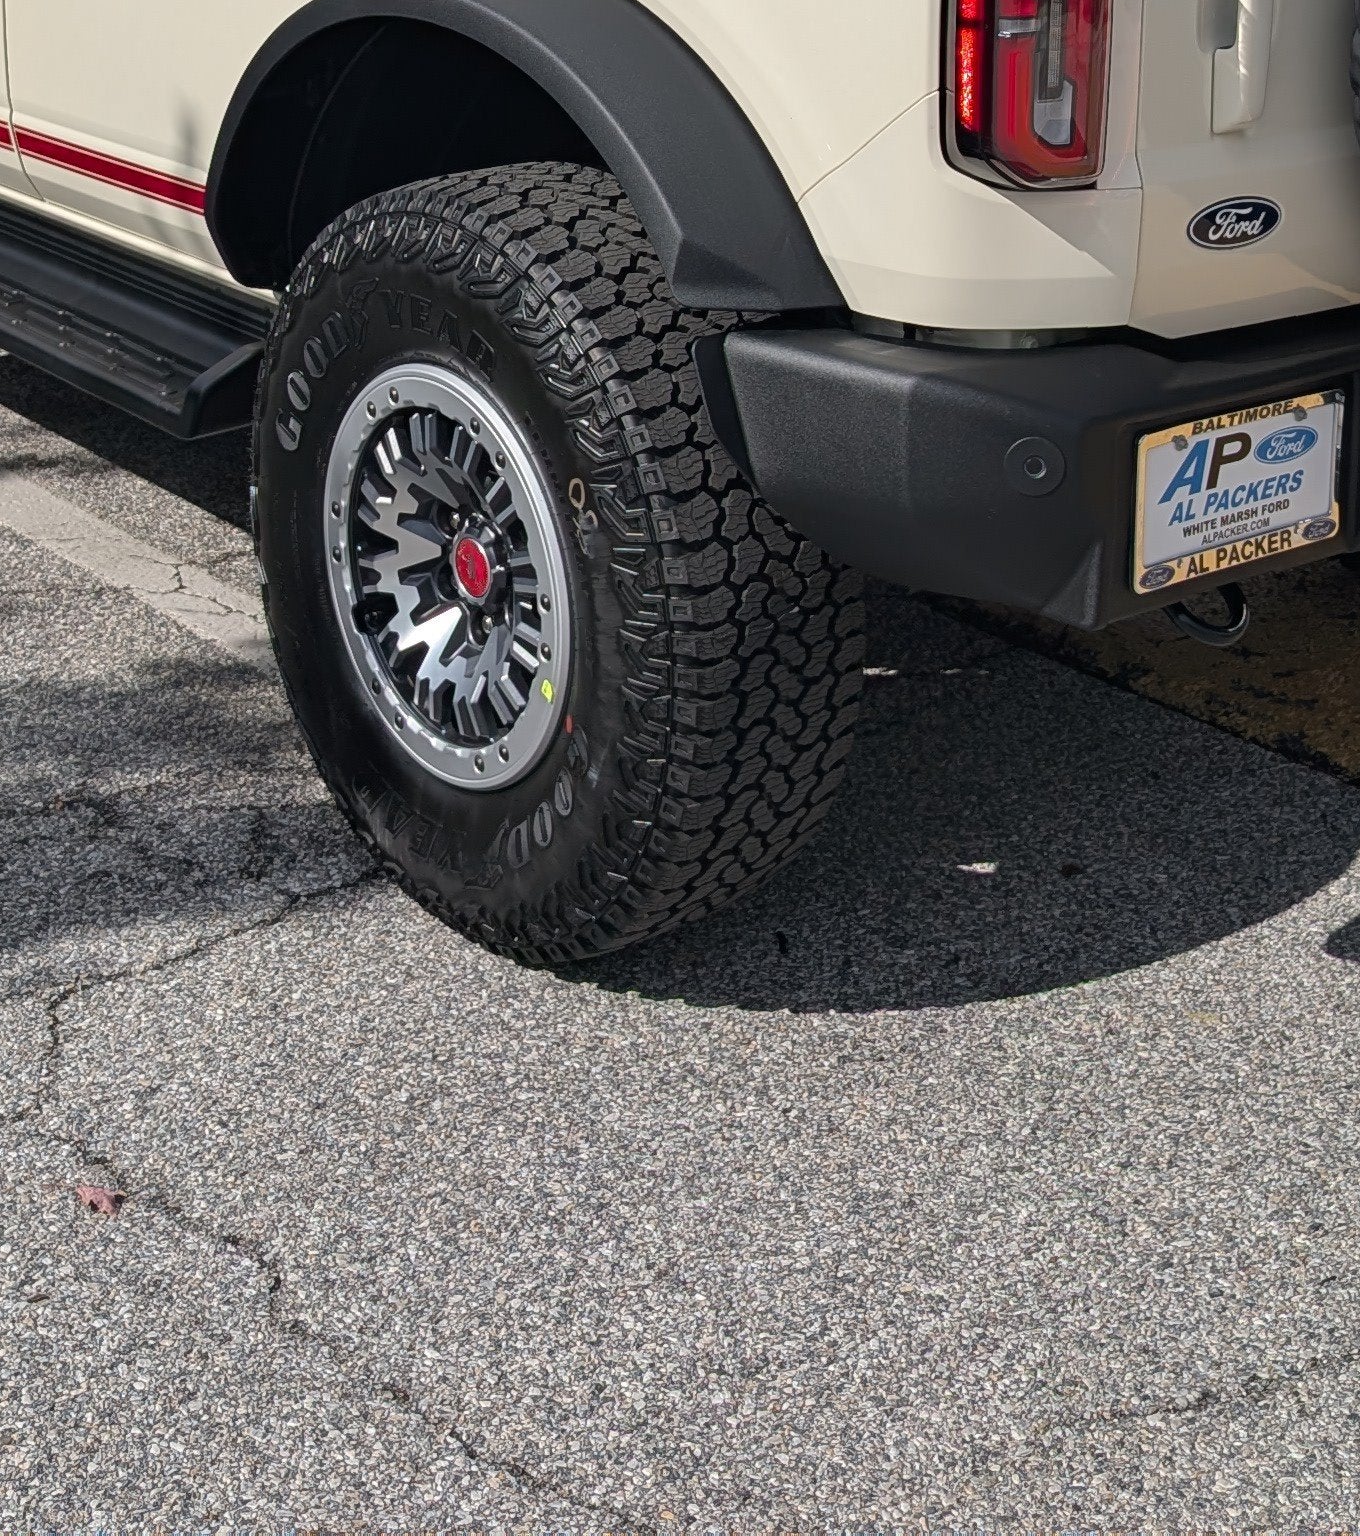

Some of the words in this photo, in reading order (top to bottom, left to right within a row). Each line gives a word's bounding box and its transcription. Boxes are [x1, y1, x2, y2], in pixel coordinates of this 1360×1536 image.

[1191, 399, 1294, 436] BALTIMORE
[1157, 431, 1252, 505] AP
[1168, 498, 1196, 527] AL
[1202, 469, 1305, 516] PACKERS
[1182, 518, 1217, 538] WHITE
[1220, 506, 1259, 528] MARSH
[1261, 498, 1290, 515] FORD
[1200, 516, 1271, 546] ALPACKER.COM
[1186, 554, 1210, 578] AL
[1215, 529, 1292, 569] PACKER
